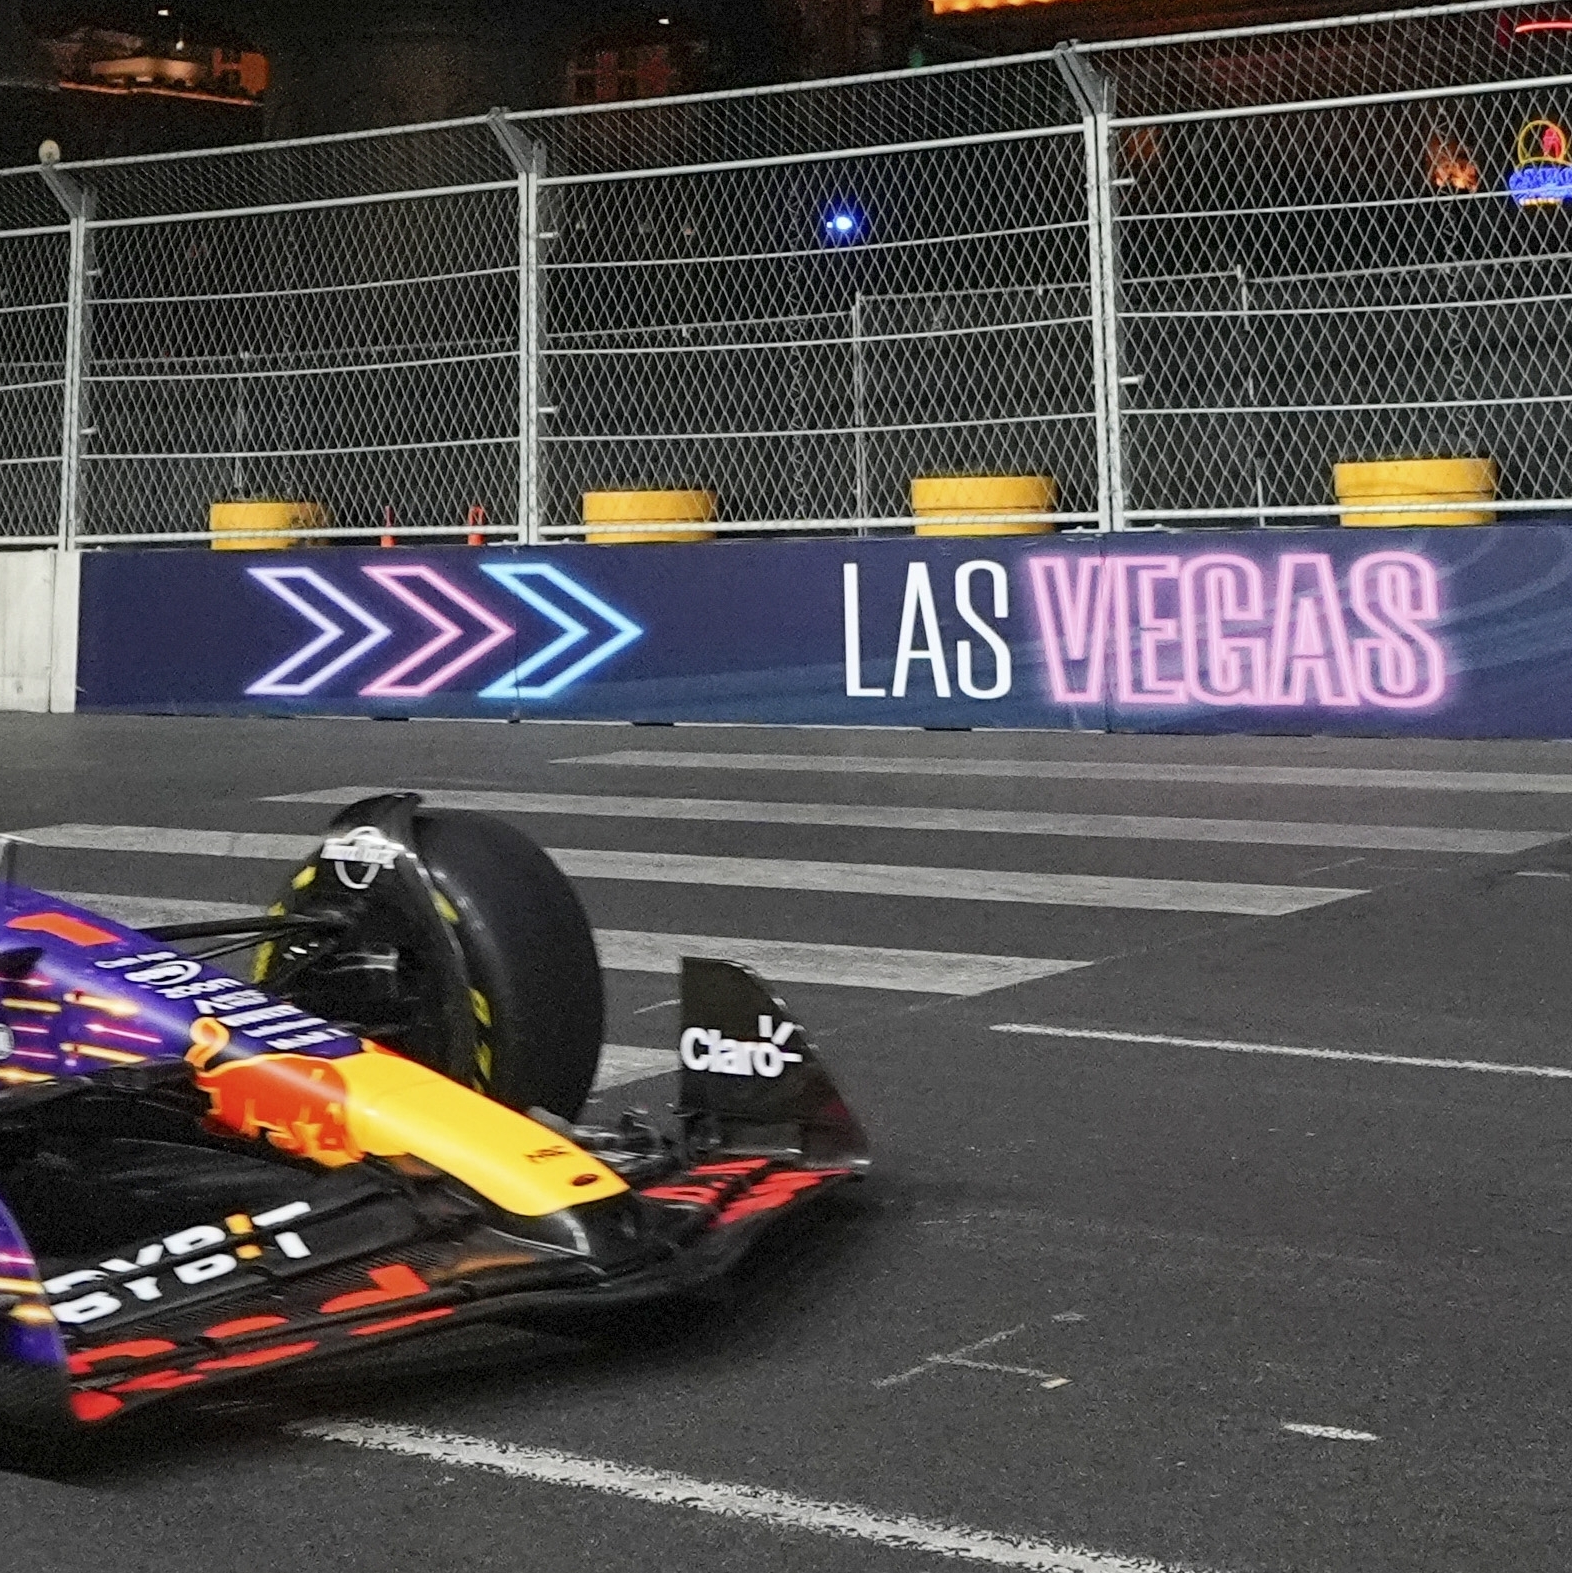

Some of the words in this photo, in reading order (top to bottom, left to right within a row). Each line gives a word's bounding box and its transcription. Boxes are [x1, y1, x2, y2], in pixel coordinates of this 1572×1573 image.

[842, 559, 1013, 700] LAS
[1028, 550, 1447, 709] VEGAS
[680, 1025, 785, 1078] Claro
